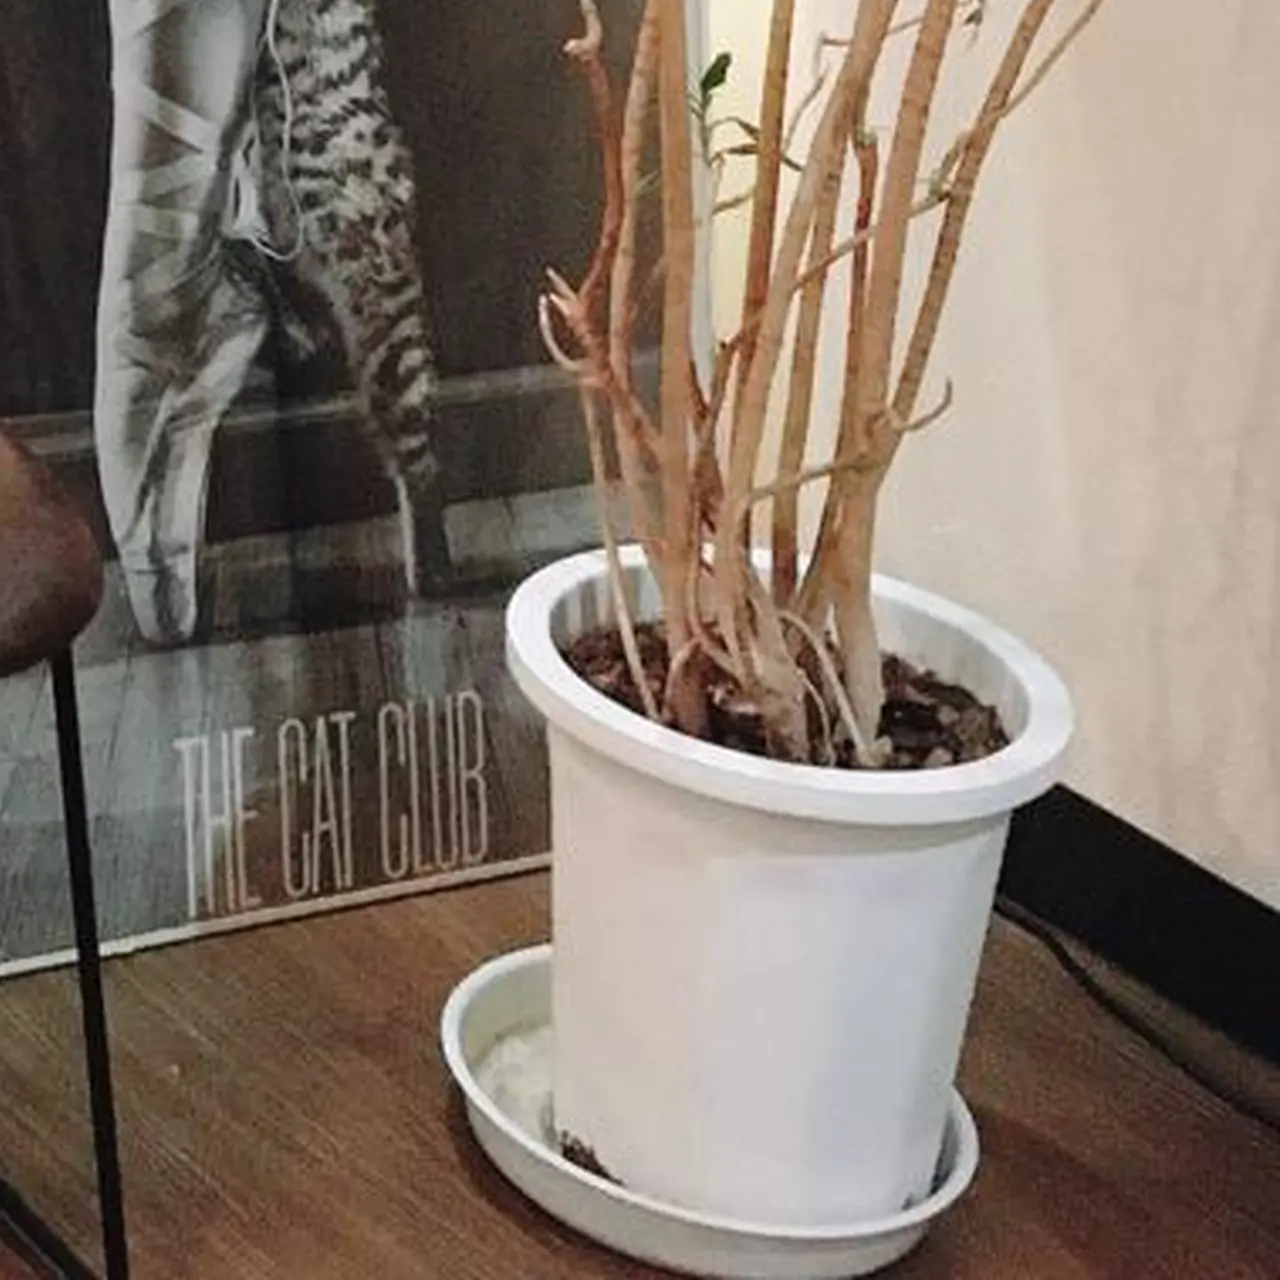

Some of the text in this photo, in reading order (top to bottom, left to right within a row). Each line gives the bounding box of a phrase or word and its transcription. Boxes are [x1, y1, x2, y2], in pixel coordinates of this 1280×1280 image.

[173, 689, 488, 920] THE CAT CLUB
